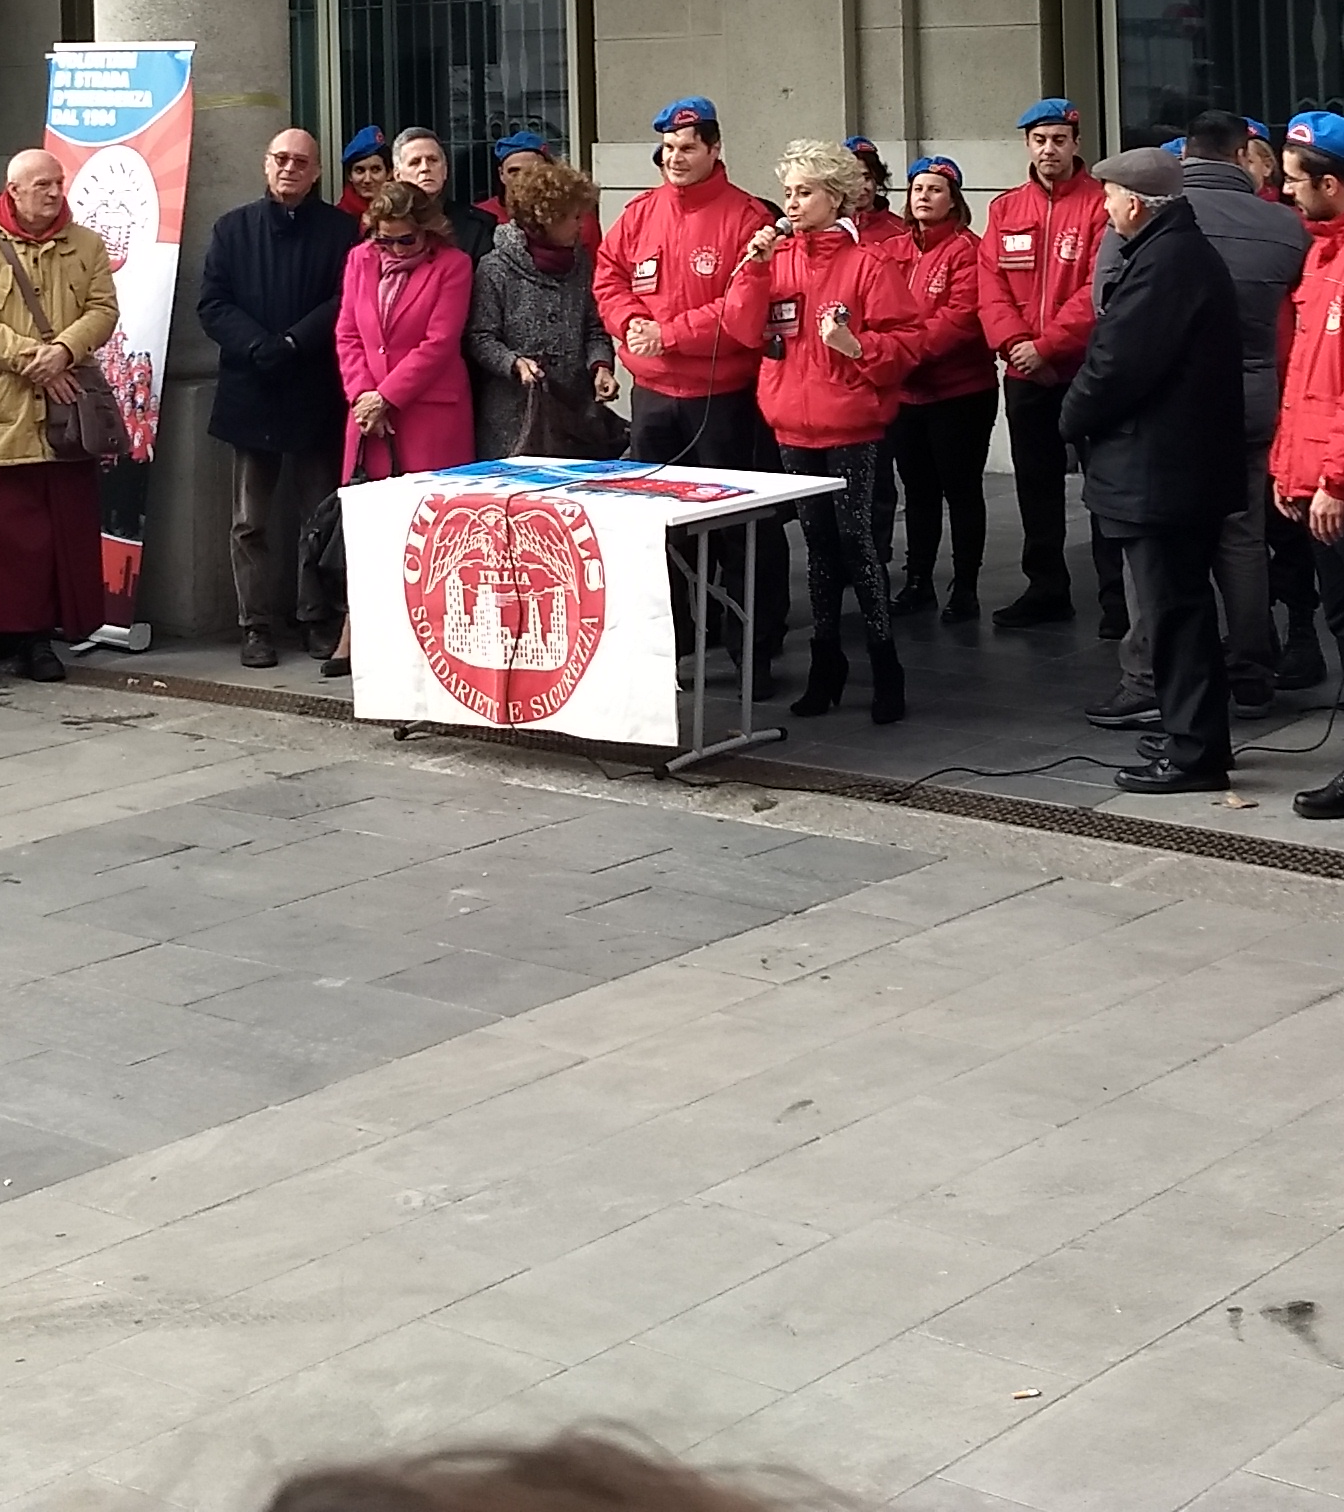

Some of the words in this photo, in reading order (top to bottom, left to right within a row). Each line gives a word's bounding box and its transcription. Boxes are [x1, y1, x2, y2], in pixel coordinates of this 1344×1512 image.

[478, 570, 531, 585] ITALIA
[508, 701, 524, 723] E
[530, 617, 599, 719] SICUREZZA
